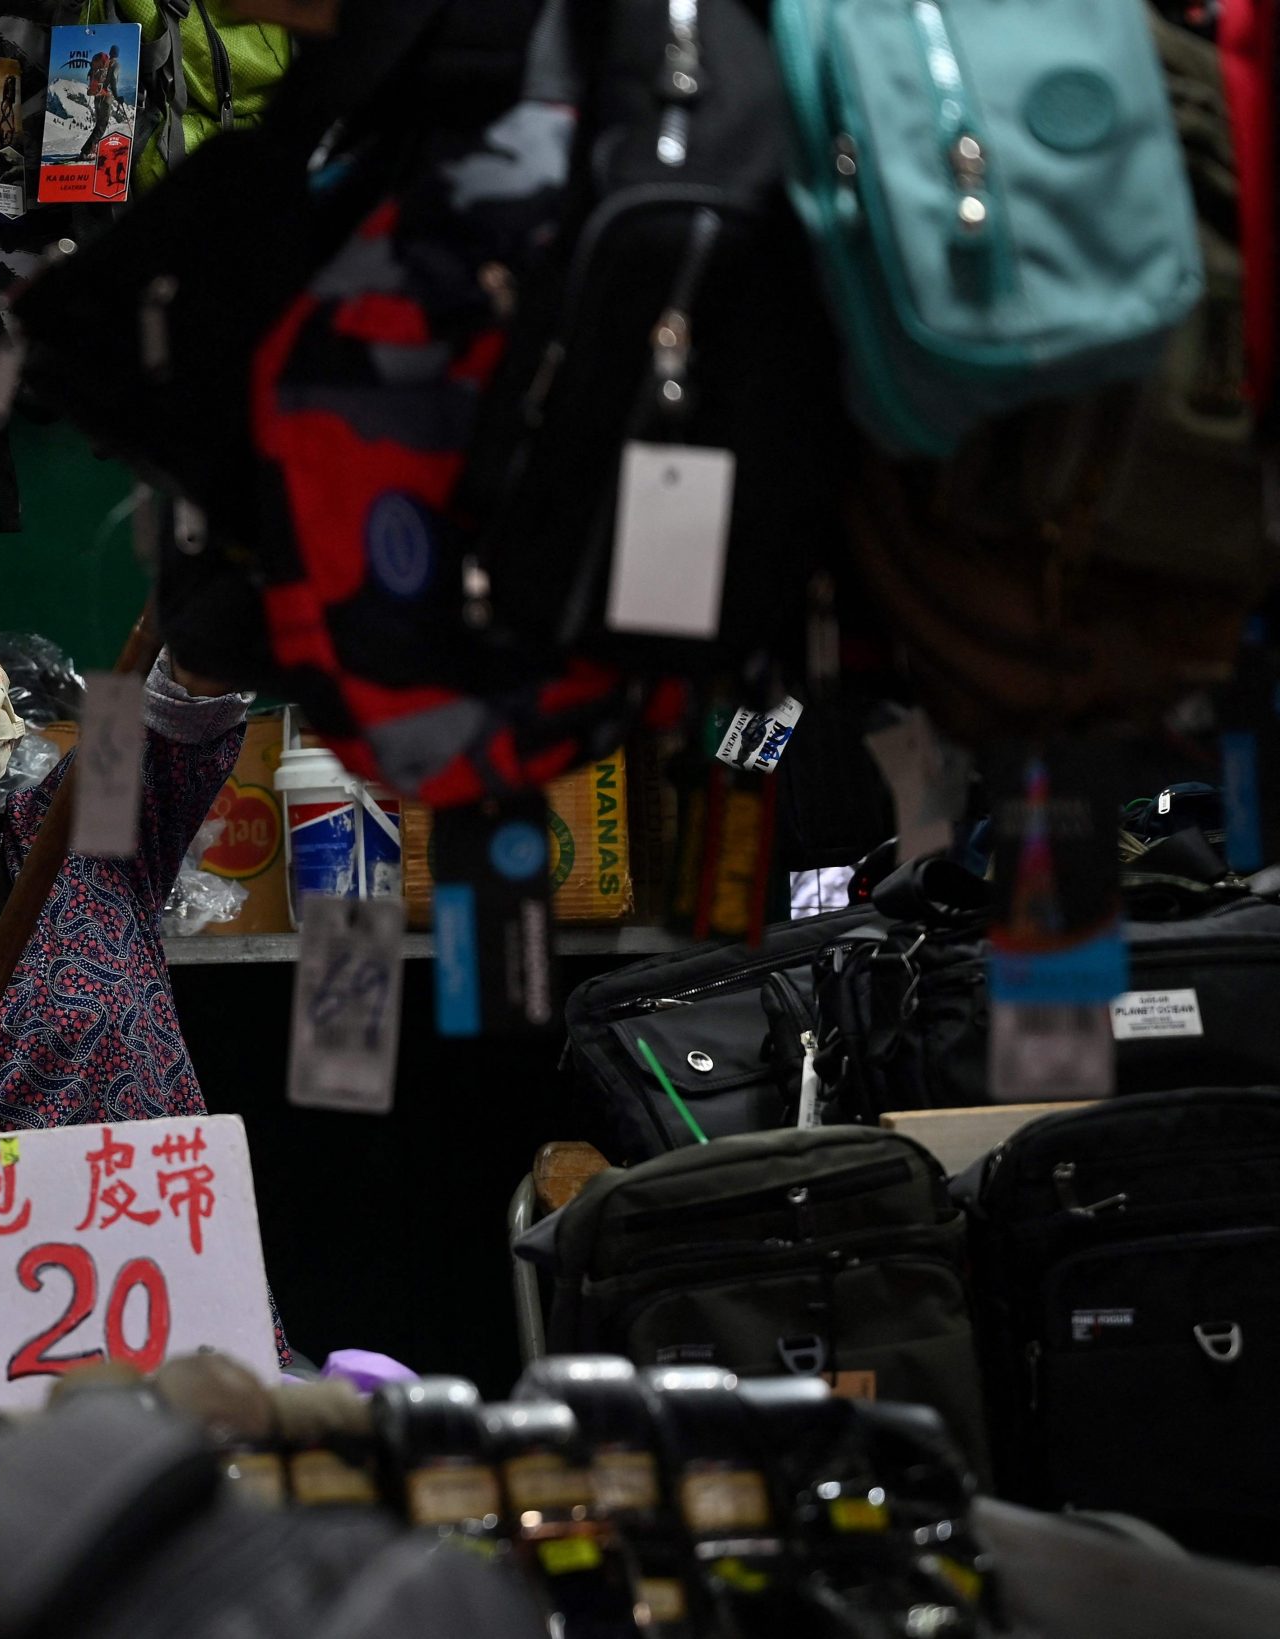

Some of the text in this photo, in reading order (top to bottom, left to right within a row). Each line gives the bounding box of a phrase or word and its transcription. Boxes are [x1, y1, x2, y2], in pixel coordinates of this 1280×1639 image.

[722, 732, 739, 757] OCEAN
[224, 818, 271, 848] Del
[596, 763, 619, 895] NANAS
